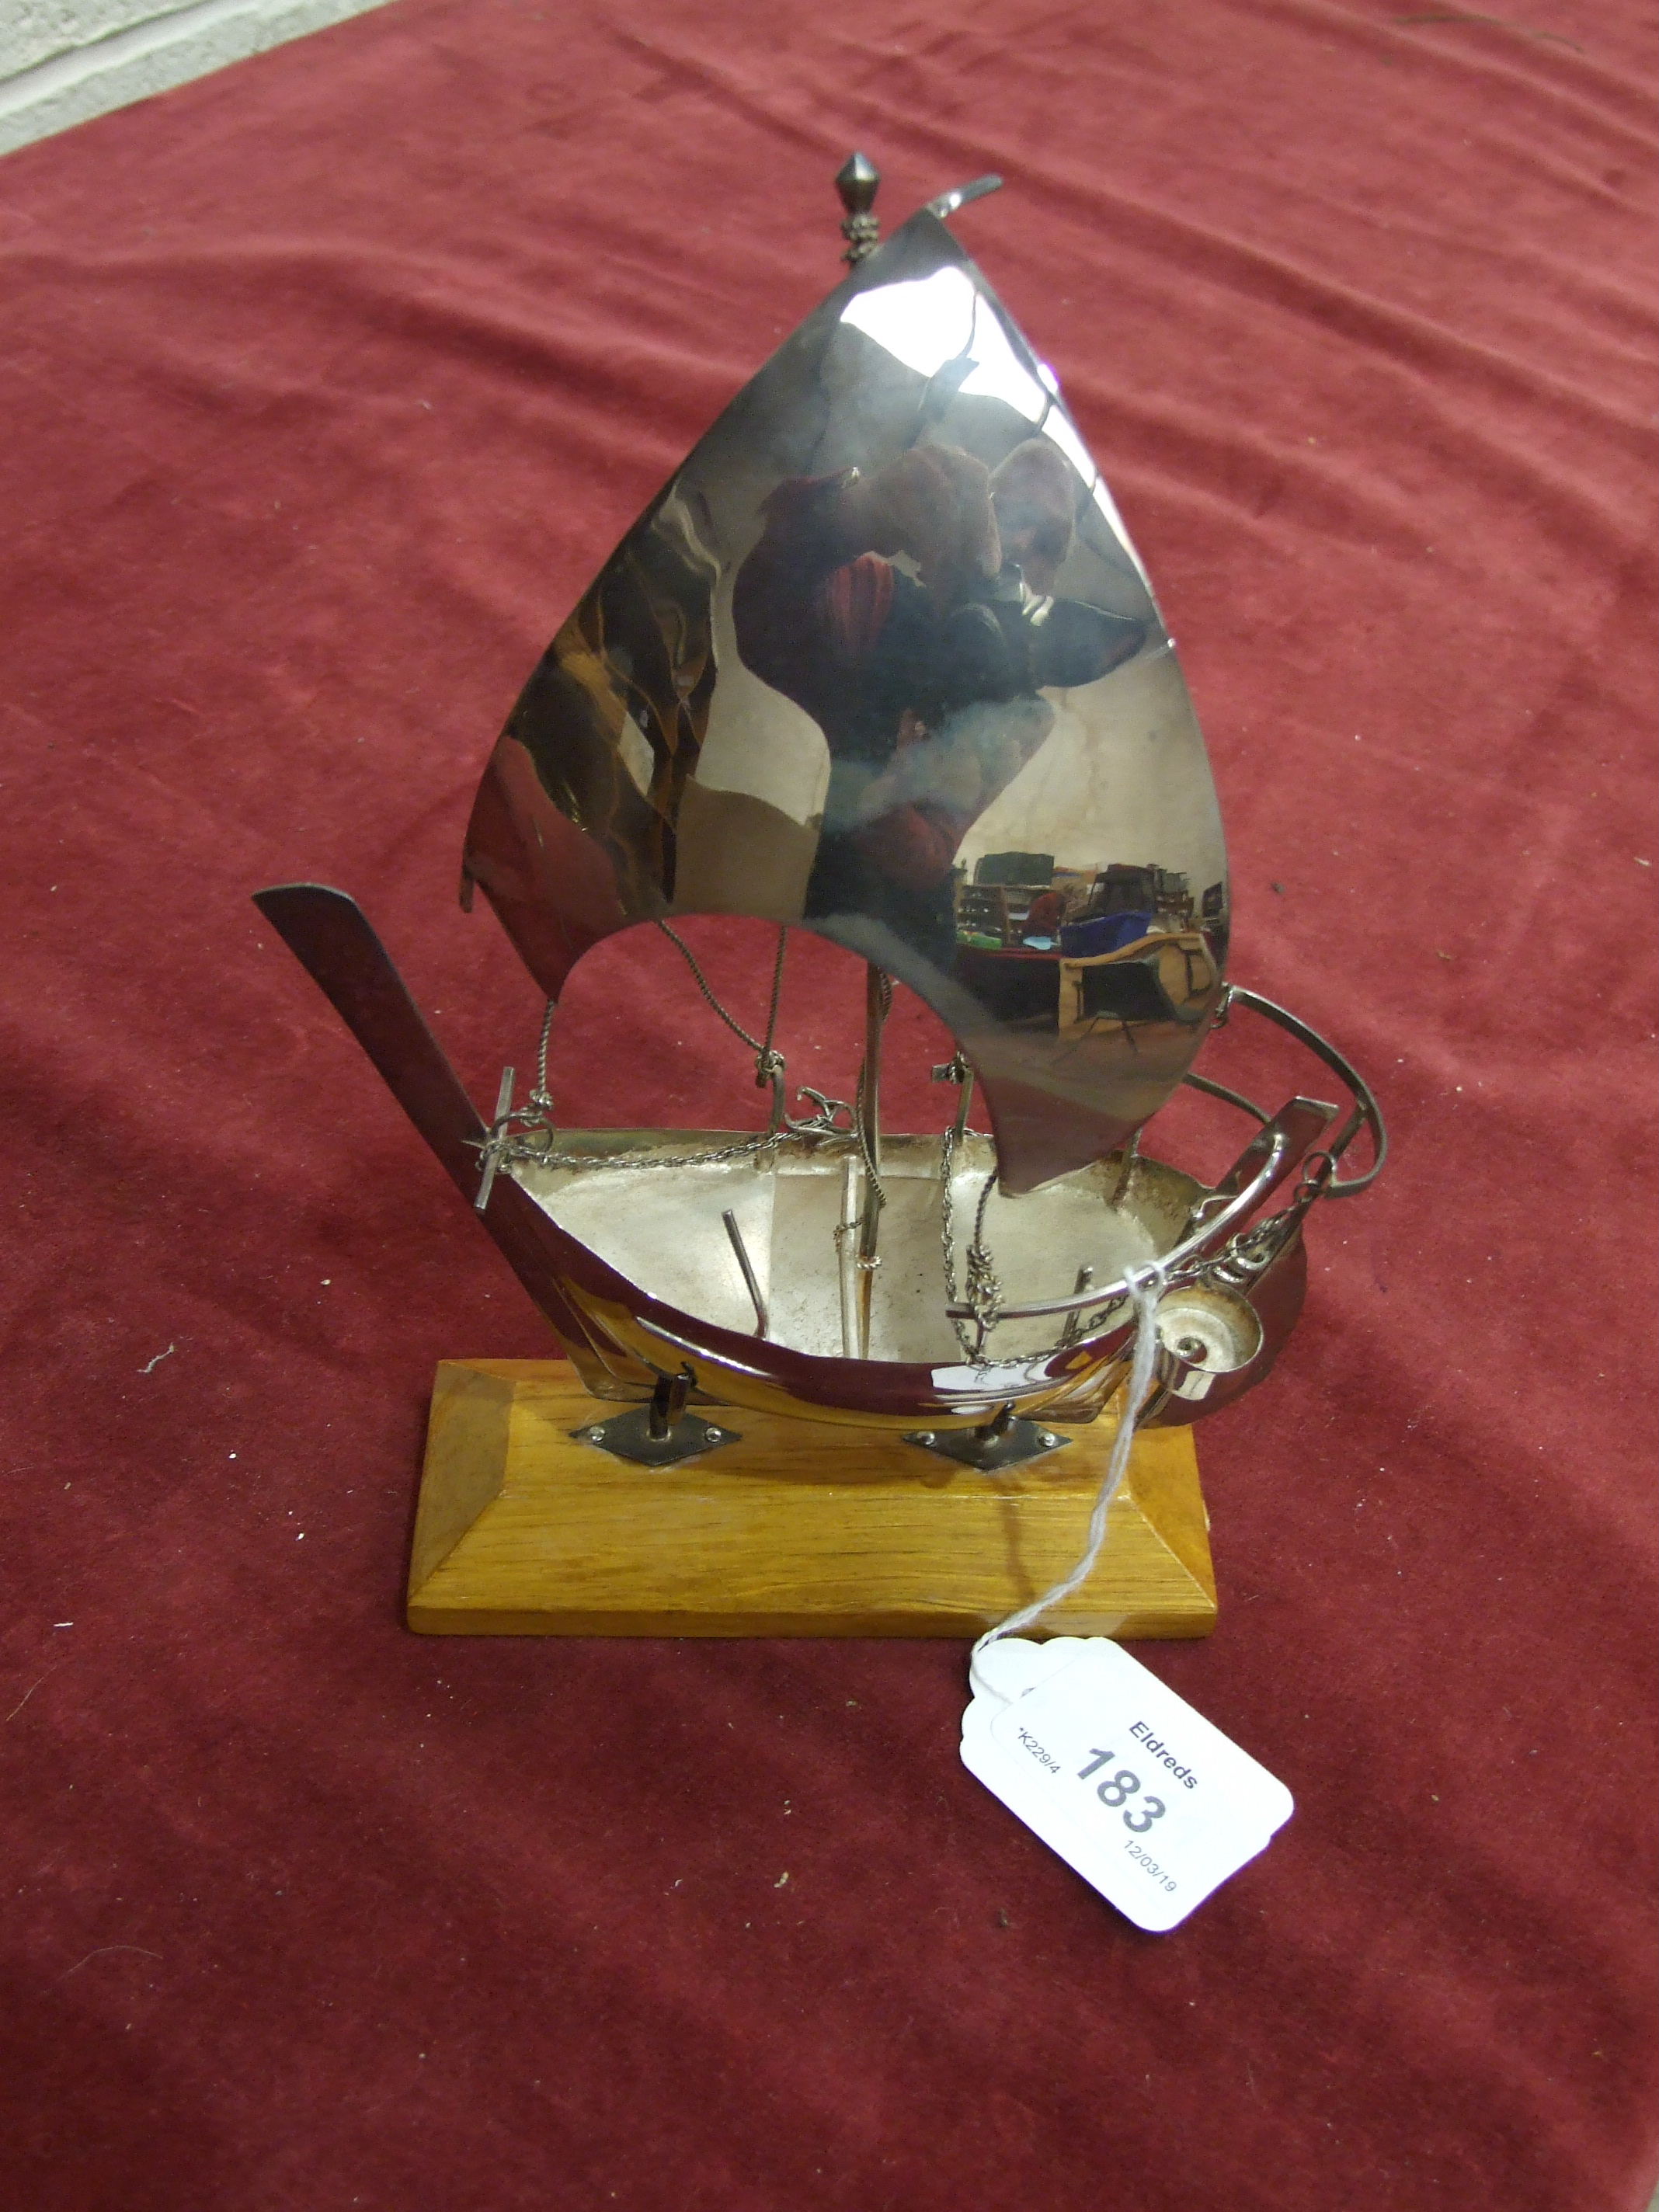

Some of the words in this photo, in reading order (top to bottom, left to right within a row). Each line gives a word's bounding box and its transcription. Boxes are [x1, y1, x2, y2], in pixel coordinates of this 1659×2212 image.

[1129, 1721, 1198, 1789] Eldreds
[1077, 1748, 1167, 1834] 183
[1125, 1841, 1177, 1892] 12/03/19
